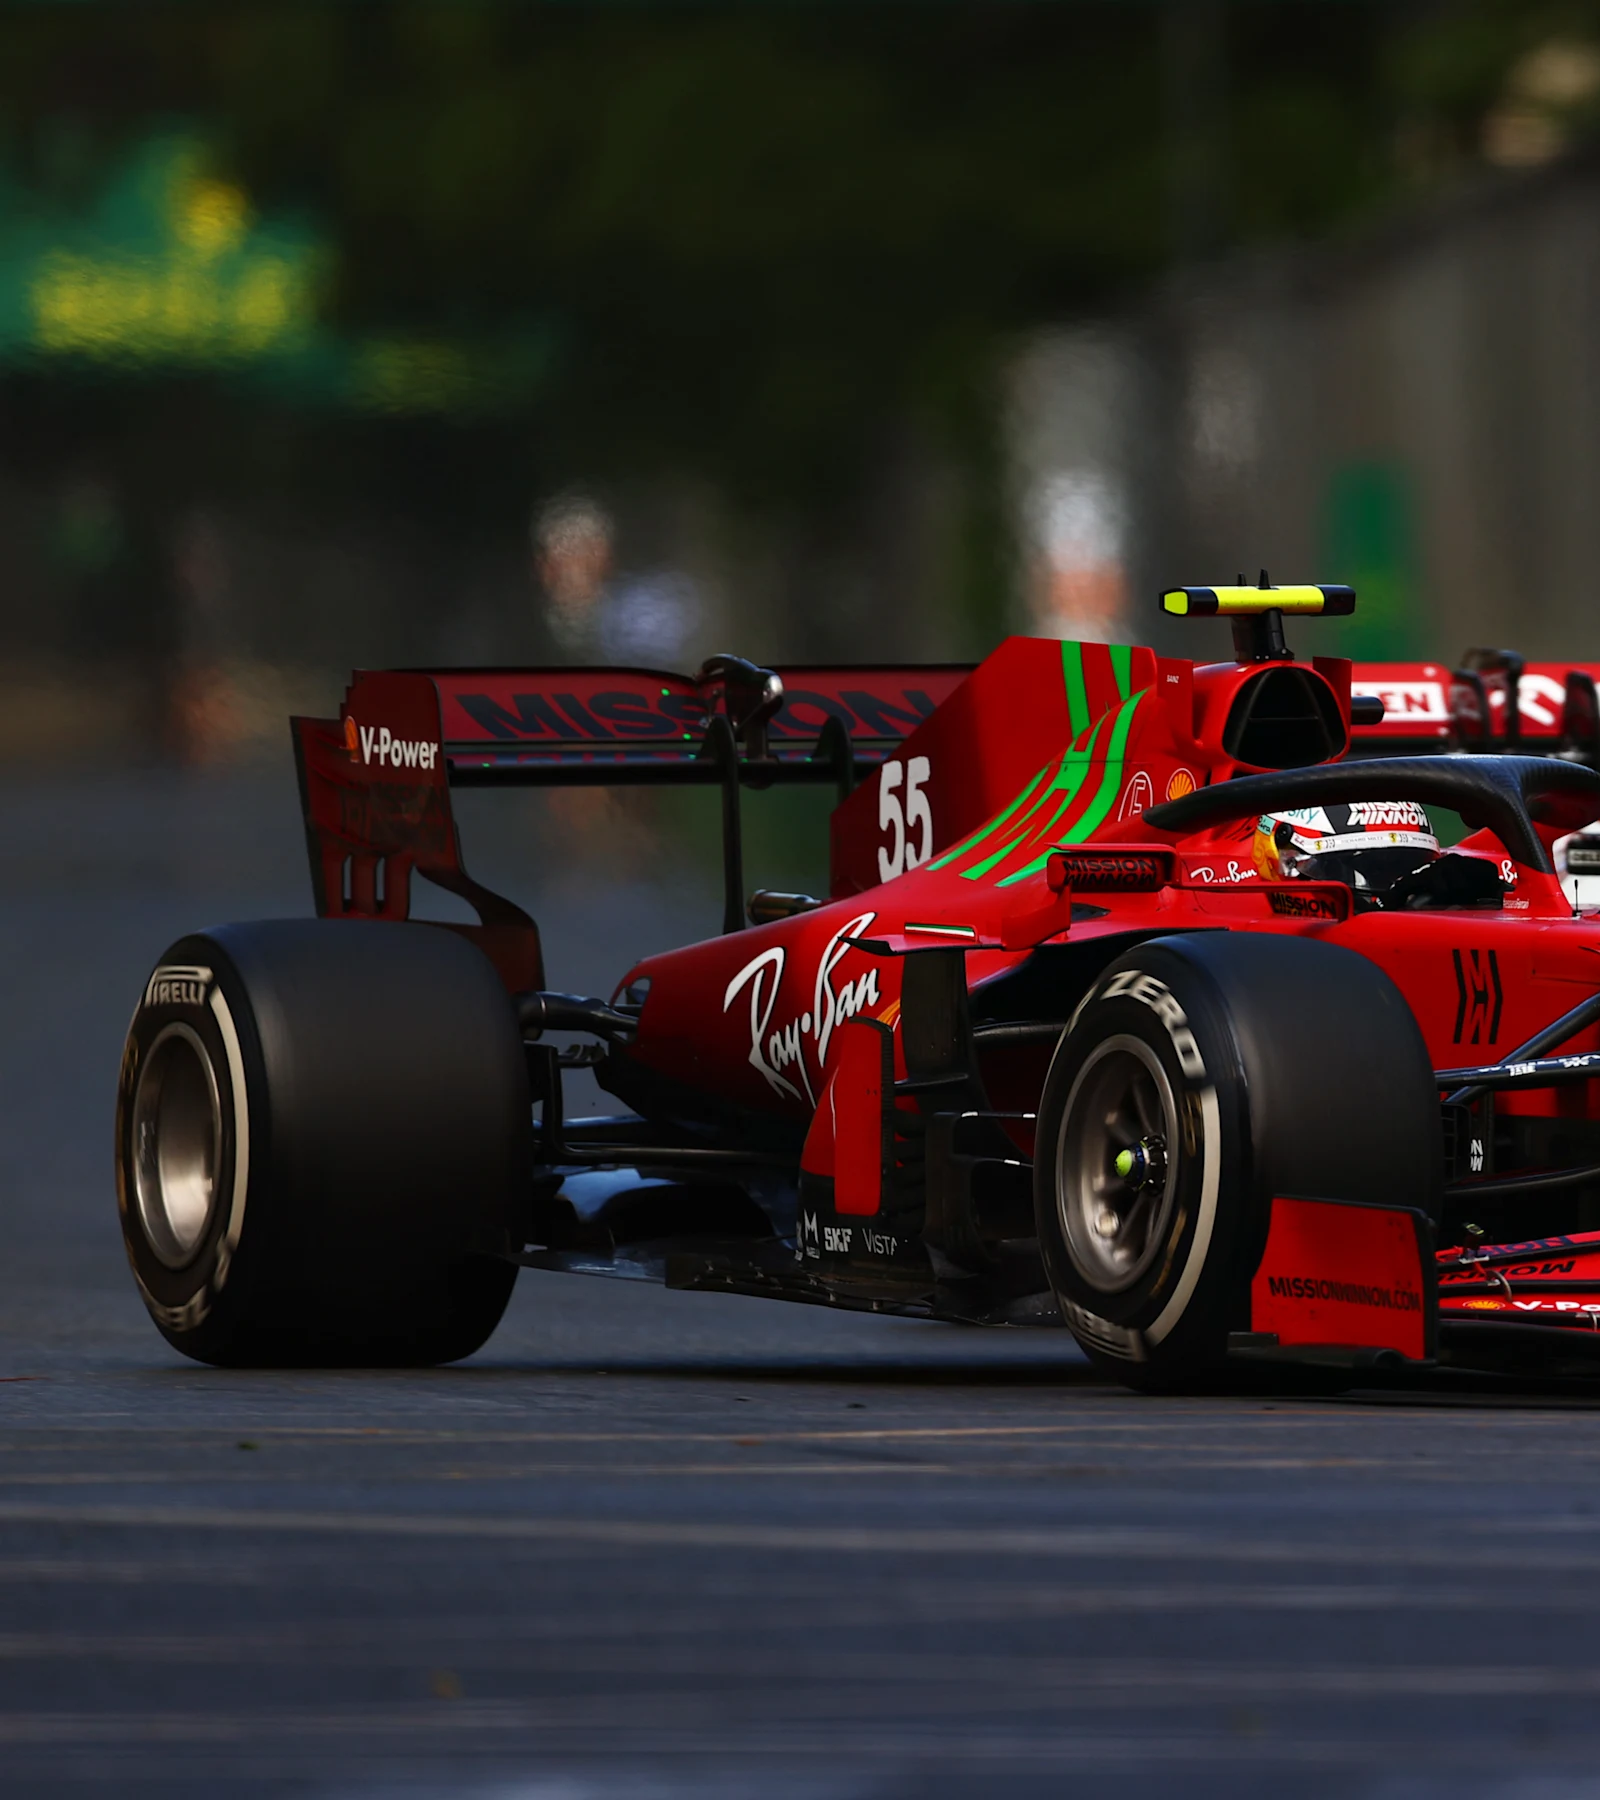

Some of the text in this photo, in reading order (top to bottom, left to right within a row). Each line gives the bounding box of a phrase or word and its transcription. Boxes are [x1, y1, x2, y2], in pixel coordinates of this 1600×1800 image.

[360, 725, 438, 769] V-Power
[877, 756, 933, 884] 55
[1346, 811, 1429, 826] WINNOW
[1063, 860, 1156, 872] MISSION
[144, 965, 214, 1007] PIRELLI
[1102, 969, 1207, 1081] ZERO
[824, 1226, 852, 1252] SKF
